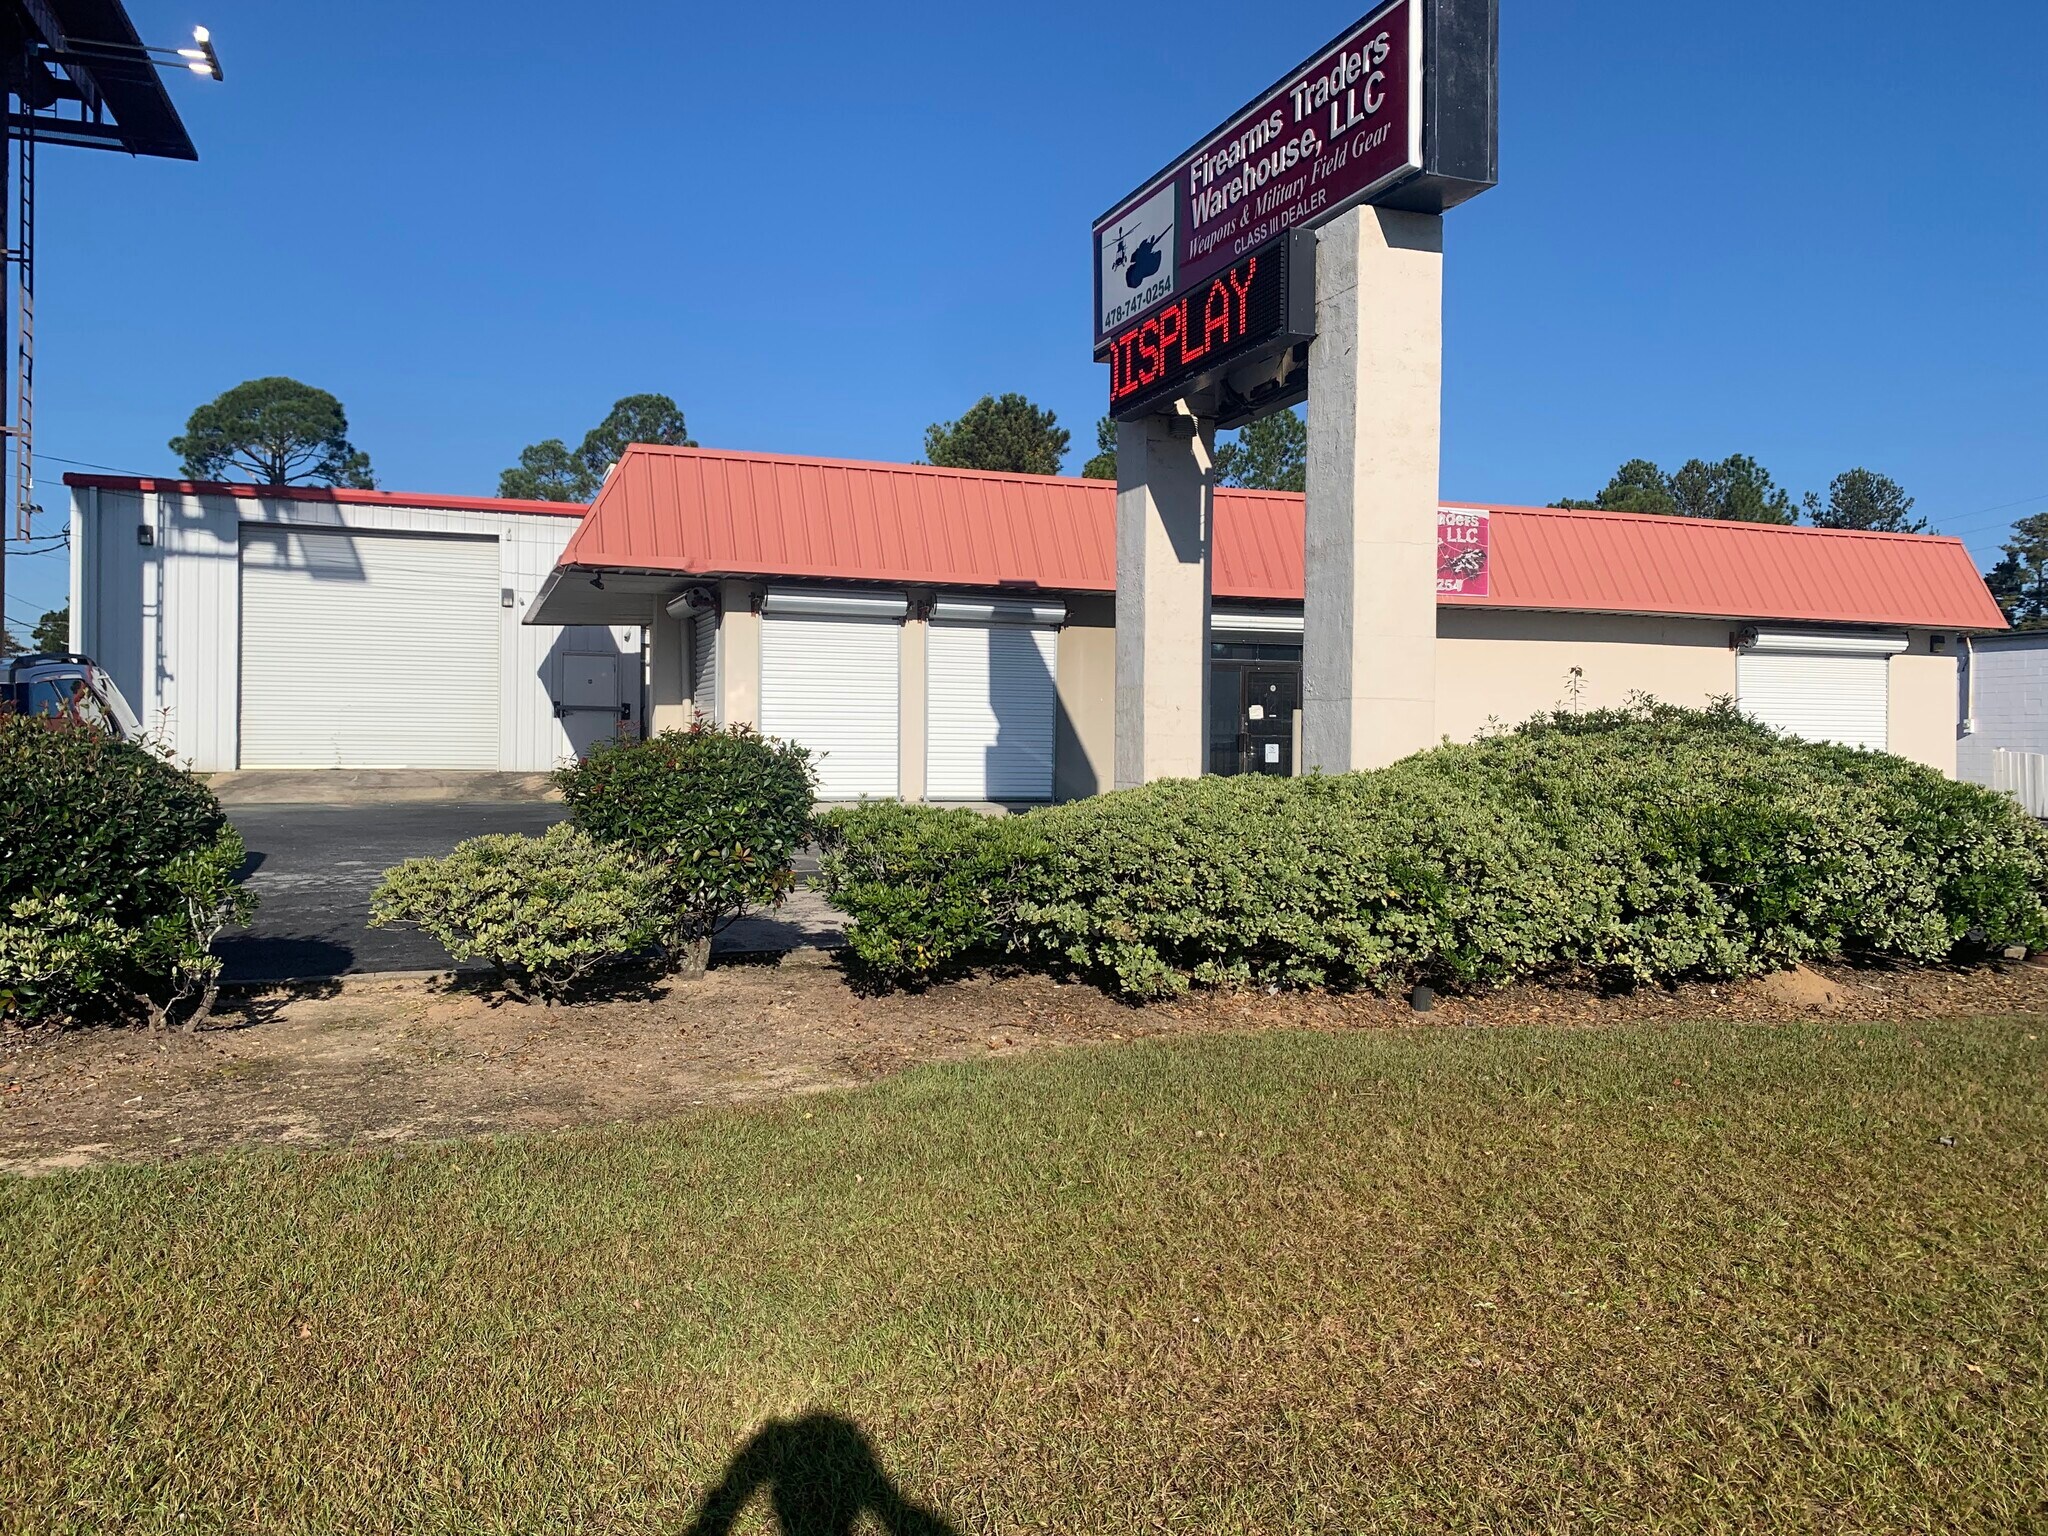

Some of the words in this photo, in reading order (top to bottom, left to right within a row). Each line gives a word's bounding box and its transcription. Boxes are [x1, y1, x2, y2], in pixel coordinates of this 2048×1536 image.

[1190, 109, 1283, 196] Firearms
[1290, 31, 1390, 122] Traders
[1191, 128, 1322, 229] Warehouse,
[1330, 70, 1386, 140] LLC
[1189, 217, 1237, 260] Weapons
[1239, 204, 1250, 226] &
[1254, 174, 1307, 220] Military
[1310, 141, 1348, 186] Field
[1352, 122, 1391, 159] Gear
[1234, 225, 1267, 255] CLASS
[1269, 215, 1279, 234] III
[1281, 188, 1327, 227] DEALER
[1104, 275, 1171, 328] 478-747-0254
[1446, 527, 1478, 543] LLC
